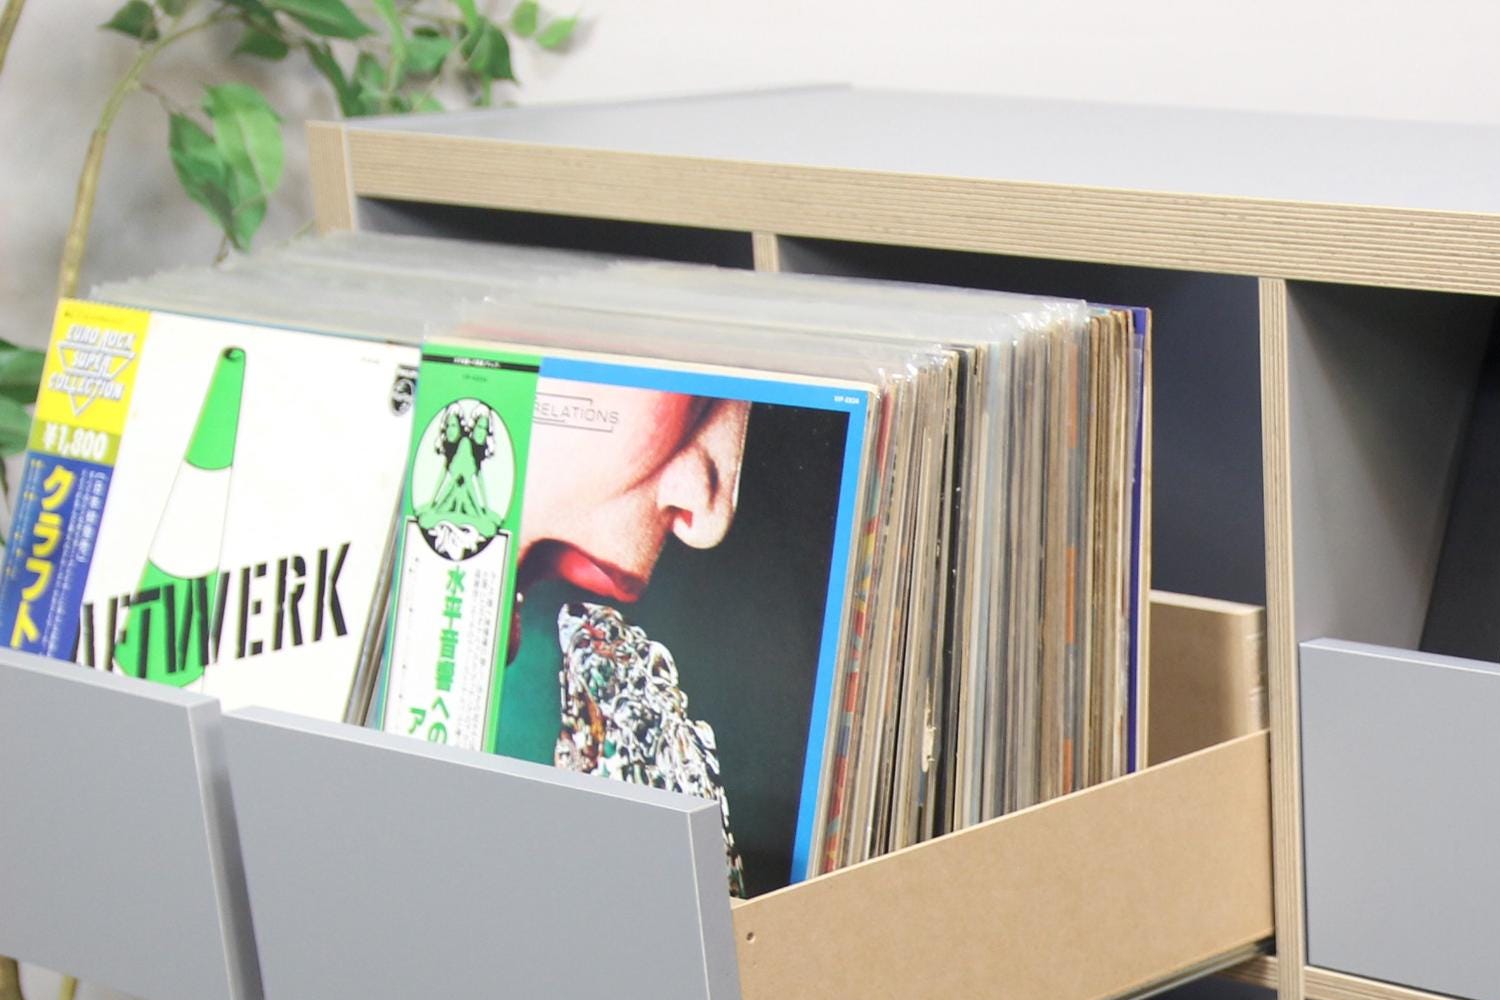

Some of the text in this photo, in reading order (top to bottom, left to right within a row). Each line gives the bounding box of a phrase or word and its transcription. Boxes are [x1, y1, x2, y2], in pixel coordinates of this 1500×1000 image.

[48, 371, 125, 402] COLLECTION
[10, 464, 76, 650] クラフト
